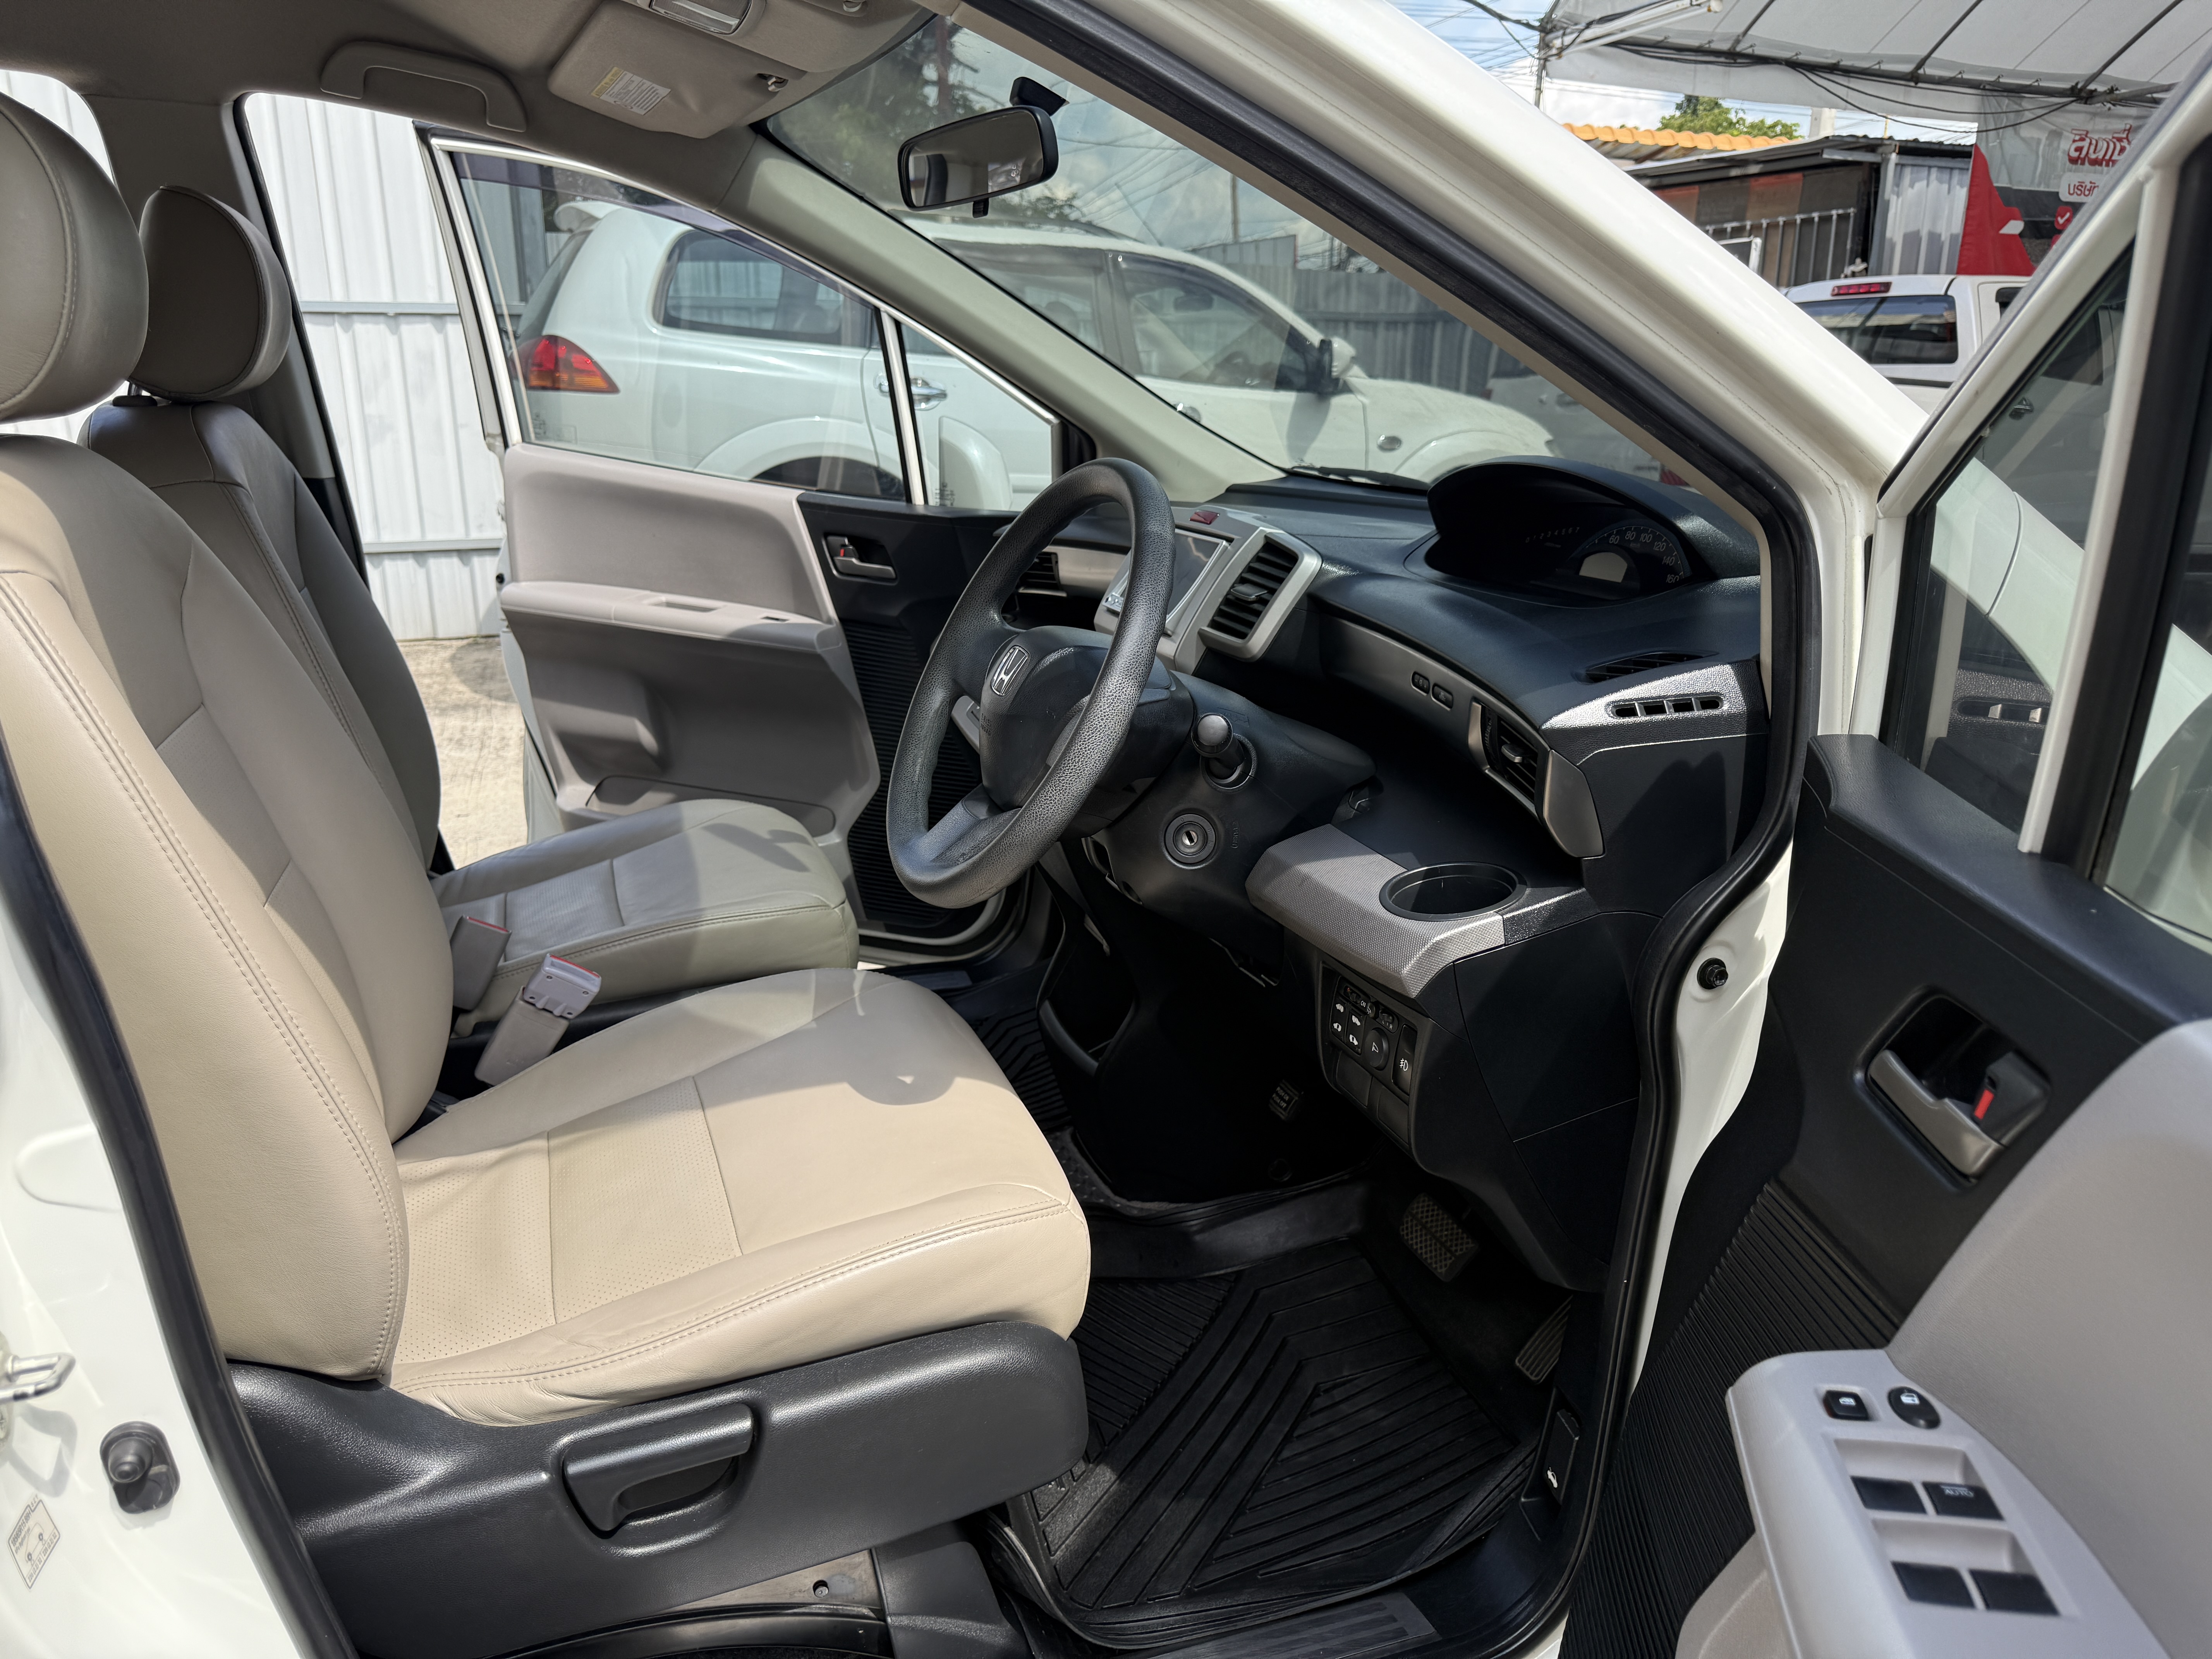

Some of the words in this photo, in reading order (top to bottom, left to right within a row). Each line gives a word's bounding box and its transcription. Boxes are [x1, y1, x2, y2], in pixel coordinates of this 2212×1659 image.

[1609, 535, 1620, 544] 60
[1625, 531, 1636, 540] 80
[1640, 532, 1652, 543] 100
[1653, 541, 1666, 551] 120
[1662, 556, 1675, 566] 140
[1945, 1489, 1973, 1497] AUTO
